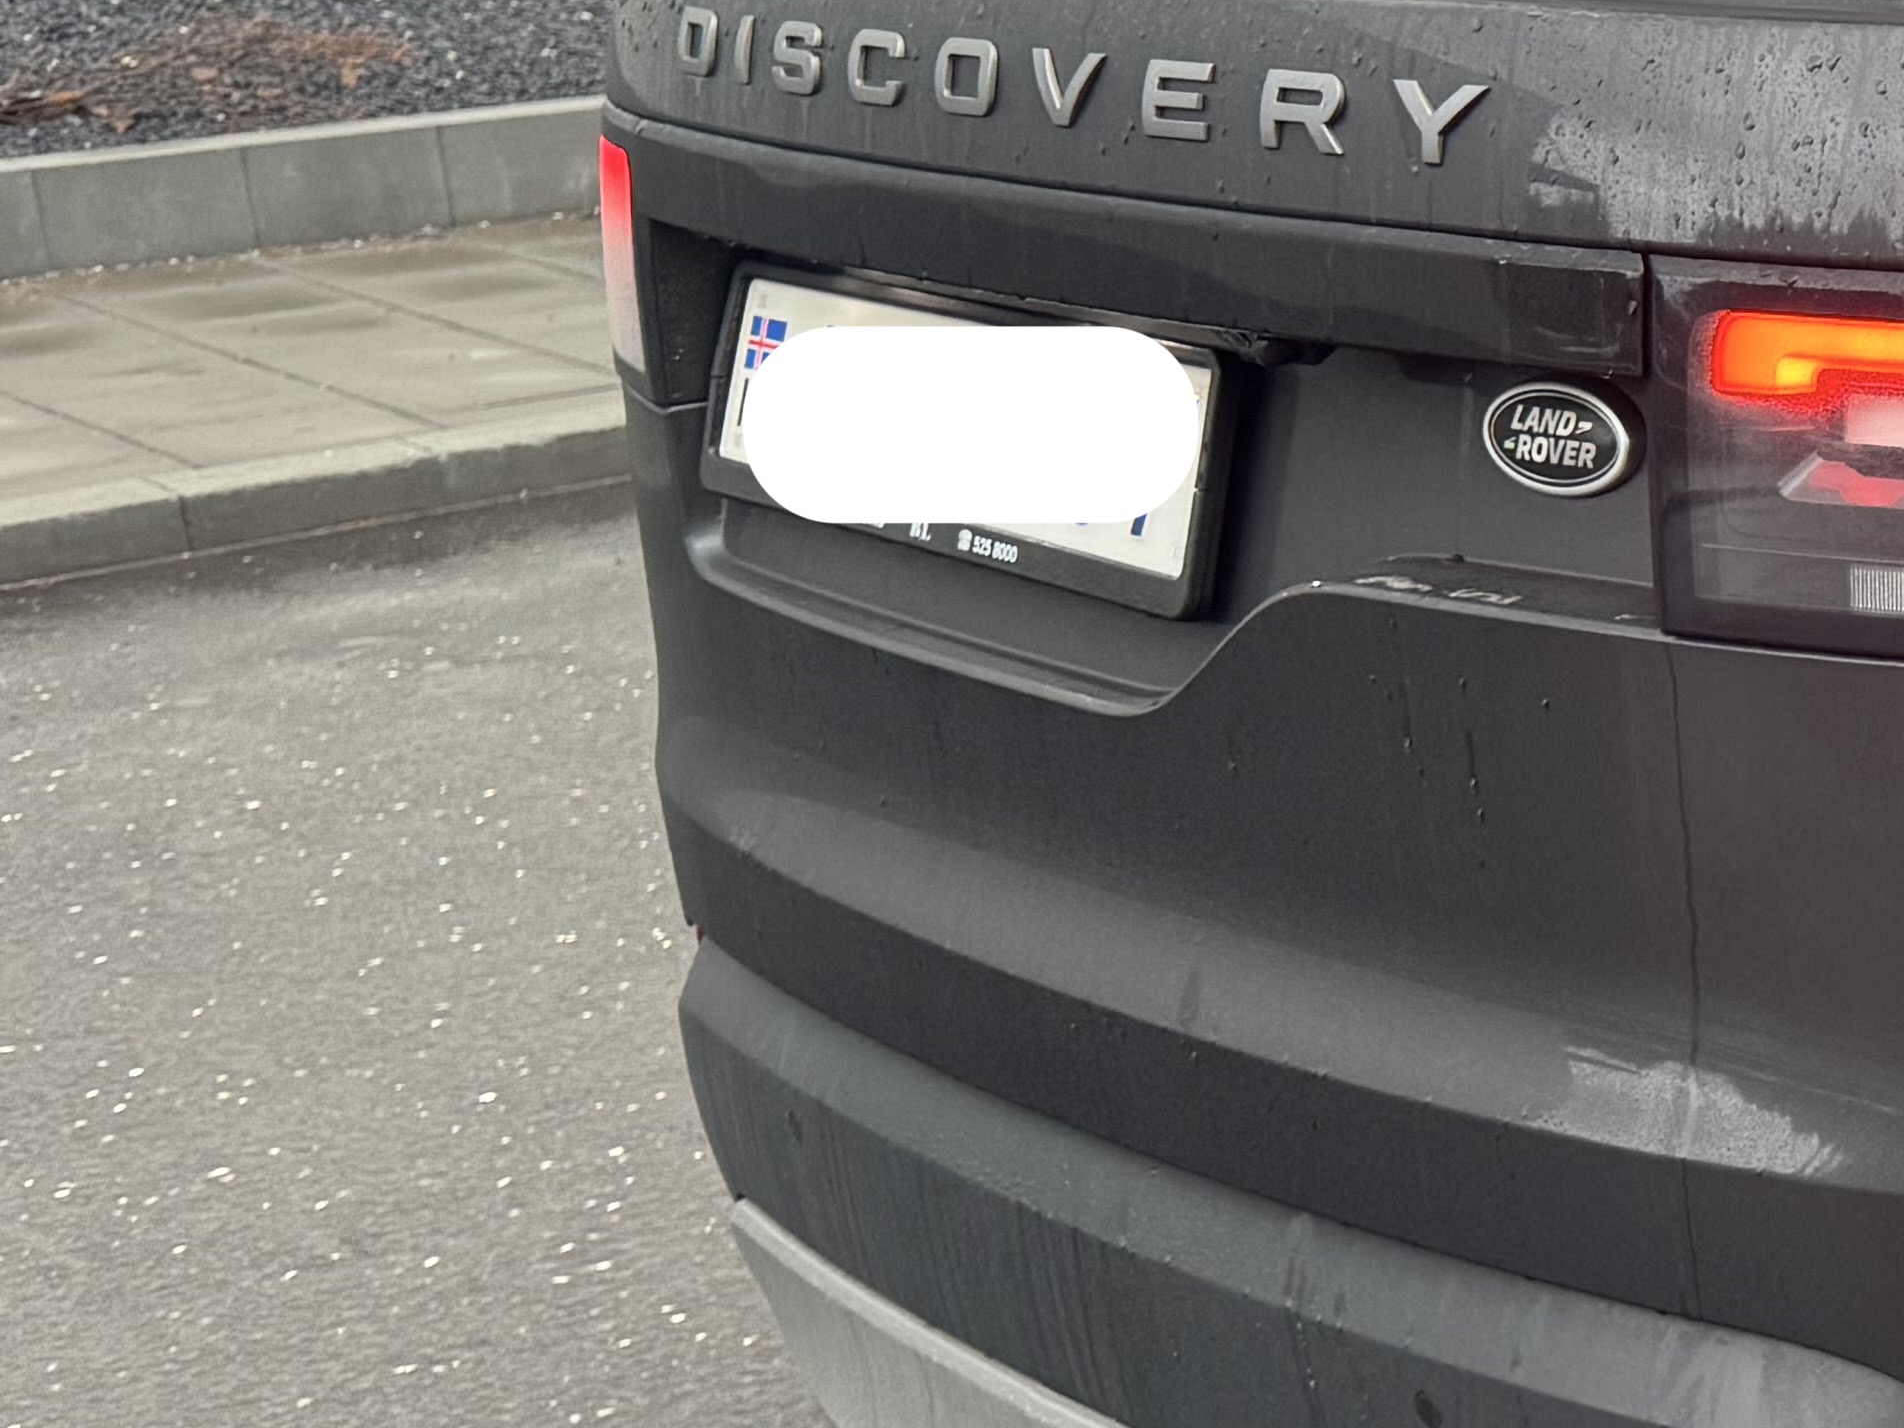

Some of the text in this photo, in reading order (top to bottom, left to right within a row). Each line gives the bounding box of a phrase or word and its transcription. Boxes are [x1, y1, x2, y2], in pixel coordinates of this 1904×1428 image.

[677, 6, 1491, 164] DISCOVERY
[1511, 404, 1577, 436] LAND
[1516, 434, 1597, 469] ROVER
